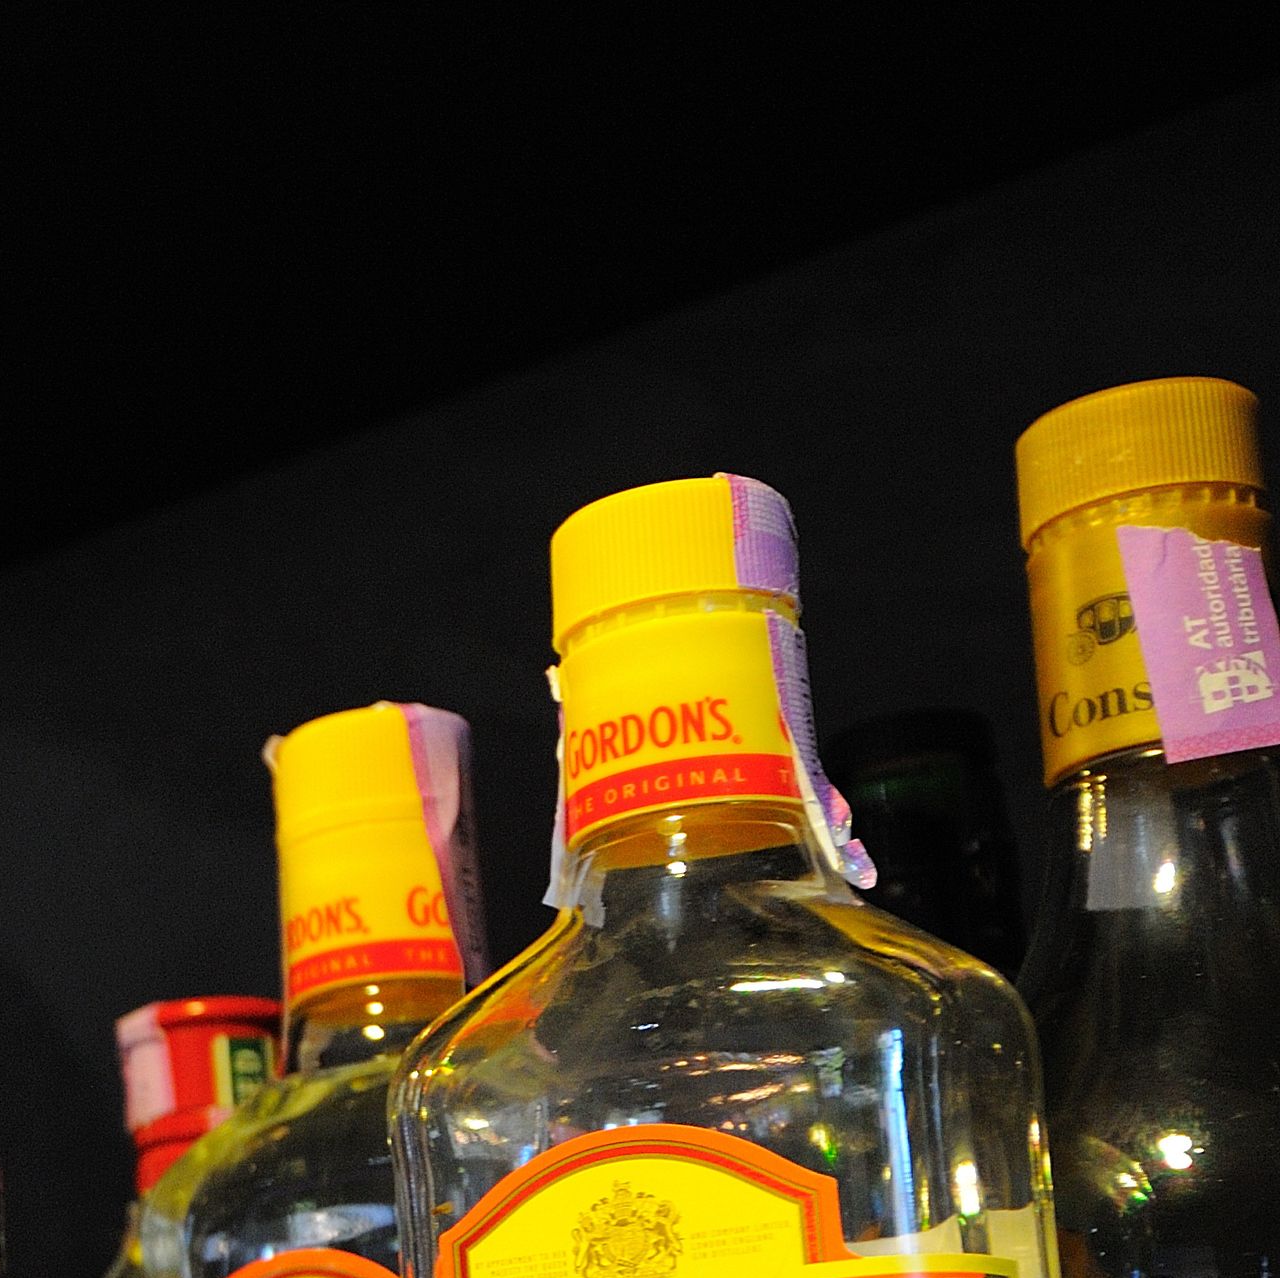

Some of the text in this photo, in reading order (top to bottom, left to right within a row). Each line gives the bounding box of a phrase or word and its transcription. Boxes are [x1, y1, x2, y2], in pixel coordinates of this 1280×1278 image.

[1184, 615, 1214, 650] AT
[571, 796, 595, 822] HE
[604, 769, 748, 804] ORIGINAL
